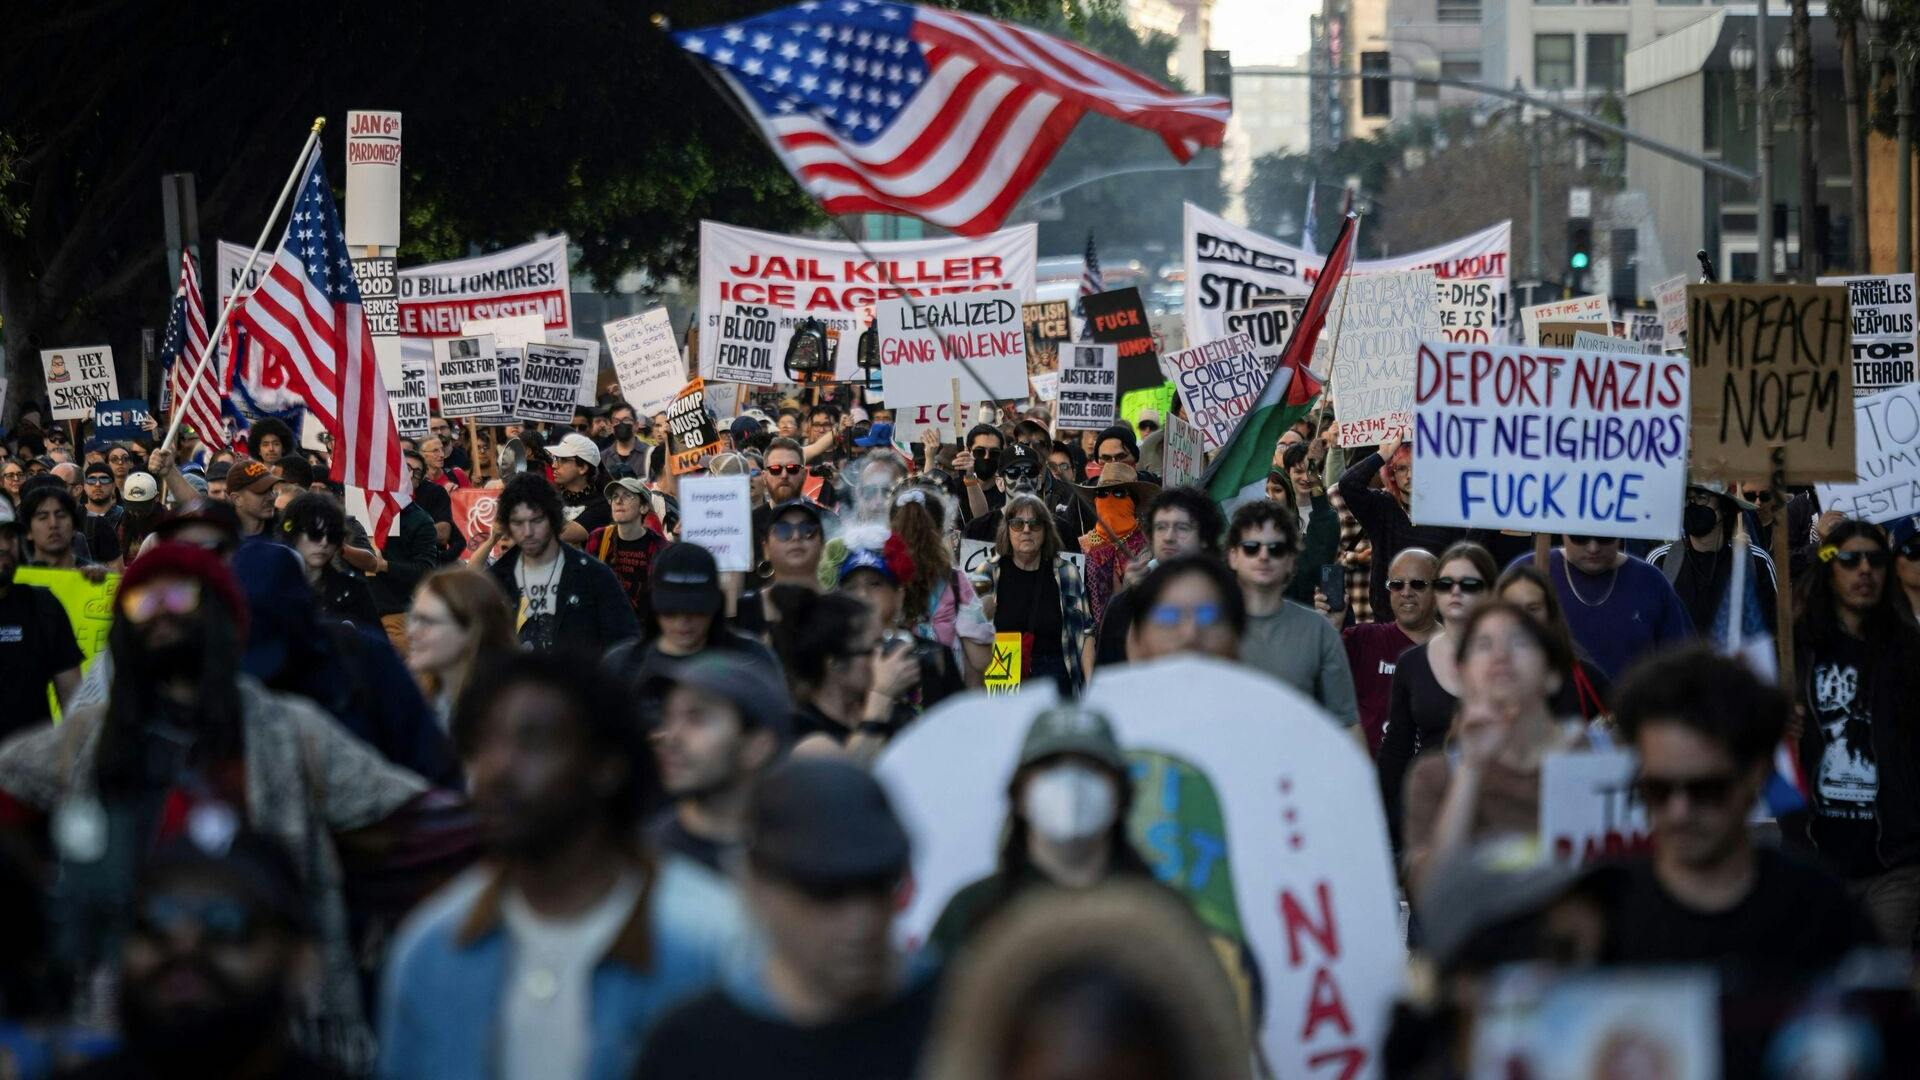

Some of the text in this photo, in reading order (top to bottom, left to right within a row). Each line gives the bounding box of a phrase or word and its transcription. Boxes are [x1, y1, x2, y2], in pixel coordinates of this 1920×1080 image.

[351, 114, 399, 135] JAN 6th
[349, 142, 402, 163] PARDONED?
[1198, 239, 1253, 264] JAN
[1254, 256, 1295, 276] 20
[418, 262, 557, 297] BILLIONAIRES!
[730, 255, 1003, 284] JAIL KILLER
[720, 281, 796, 310] ICE
[1846, 280, 1886, 289] FROM
[1851, 284, 1912, 306] ANGELES
[421, 303, 469, 333] NEW
[735, 304, 769, 319] NO
[901, 298, 1016, 331] LEGALIZED
[1463, 311, 1485, 328] IS
[1555, 303, 1580, 316] TIME
[1584, 300, 1601, 311] WE
[1857, 309, 1878, 317] TO
[723, 316, 777, 344] BLOOD
[1039, 320, 1068, 338] ICE
[1094, 309, 1140, 333] FUCK
[1227, 310, 1289, 346] STOP
[1691, 293, 1849, 371] IMPEACH
[881, 330, 1024, 366] GANG VIOLENCE
[1169, 346, 1207, 372] YOU
[1203, 332, 1256, 363] EITHER
[1578, 337, 1609, 351] NORTH
[78, 352, 103, 368] HEY
[440, 359, 496, 377] JUSTICE FOR
[528, 353, 584, 368] STOP
[718, 344, 773, 370] FOR OIL
[524, 363, 580, 386] BOMBING
[1061, 368, 1115, 385] JUSTICE FOR
[1180, 351, 1261, 390] CONDEM
[1415, 344, 1686, 412] DEPORT NAZIS
[1852, 360, 1915, 384] TERROR
[54, 381, 112, 406] SUCK MY
[441, 379, 497, 392] RENEE
[522, 383, 577, 403] VENEZUELA
[1060, 391, 1114, 402] RENEE
[1185, 368, 1269, 413] FACISM
[442, 389, 499, 407] NICOLE GOOD
[519, 398, 574, 413] NOW!
[667, 391, 704, 418] TRUMP
[1060, 401, 1114, 418] NICOLE GOOD
[1718, 368, 1840, 450] NOEM
[96, 411, 122, 427] ICE
[669, 409, 706, 436] MUST
[914, 403, 971, 428] ICE
[1194, 406, 1219, 429] OR
[1218, 394, 1250, 420] YOU
[1854, 394, 1920, 452] TO
[683, 428, 704, 449] GO
[1416, 410, 1488, 459] NOT
[1015, 445, 1025, 456] LA
[690, 488, 738, 503] Impeach
[1460, 470, 1652, 523] FUCK ICE.
[705, 509, 723, 519] the
